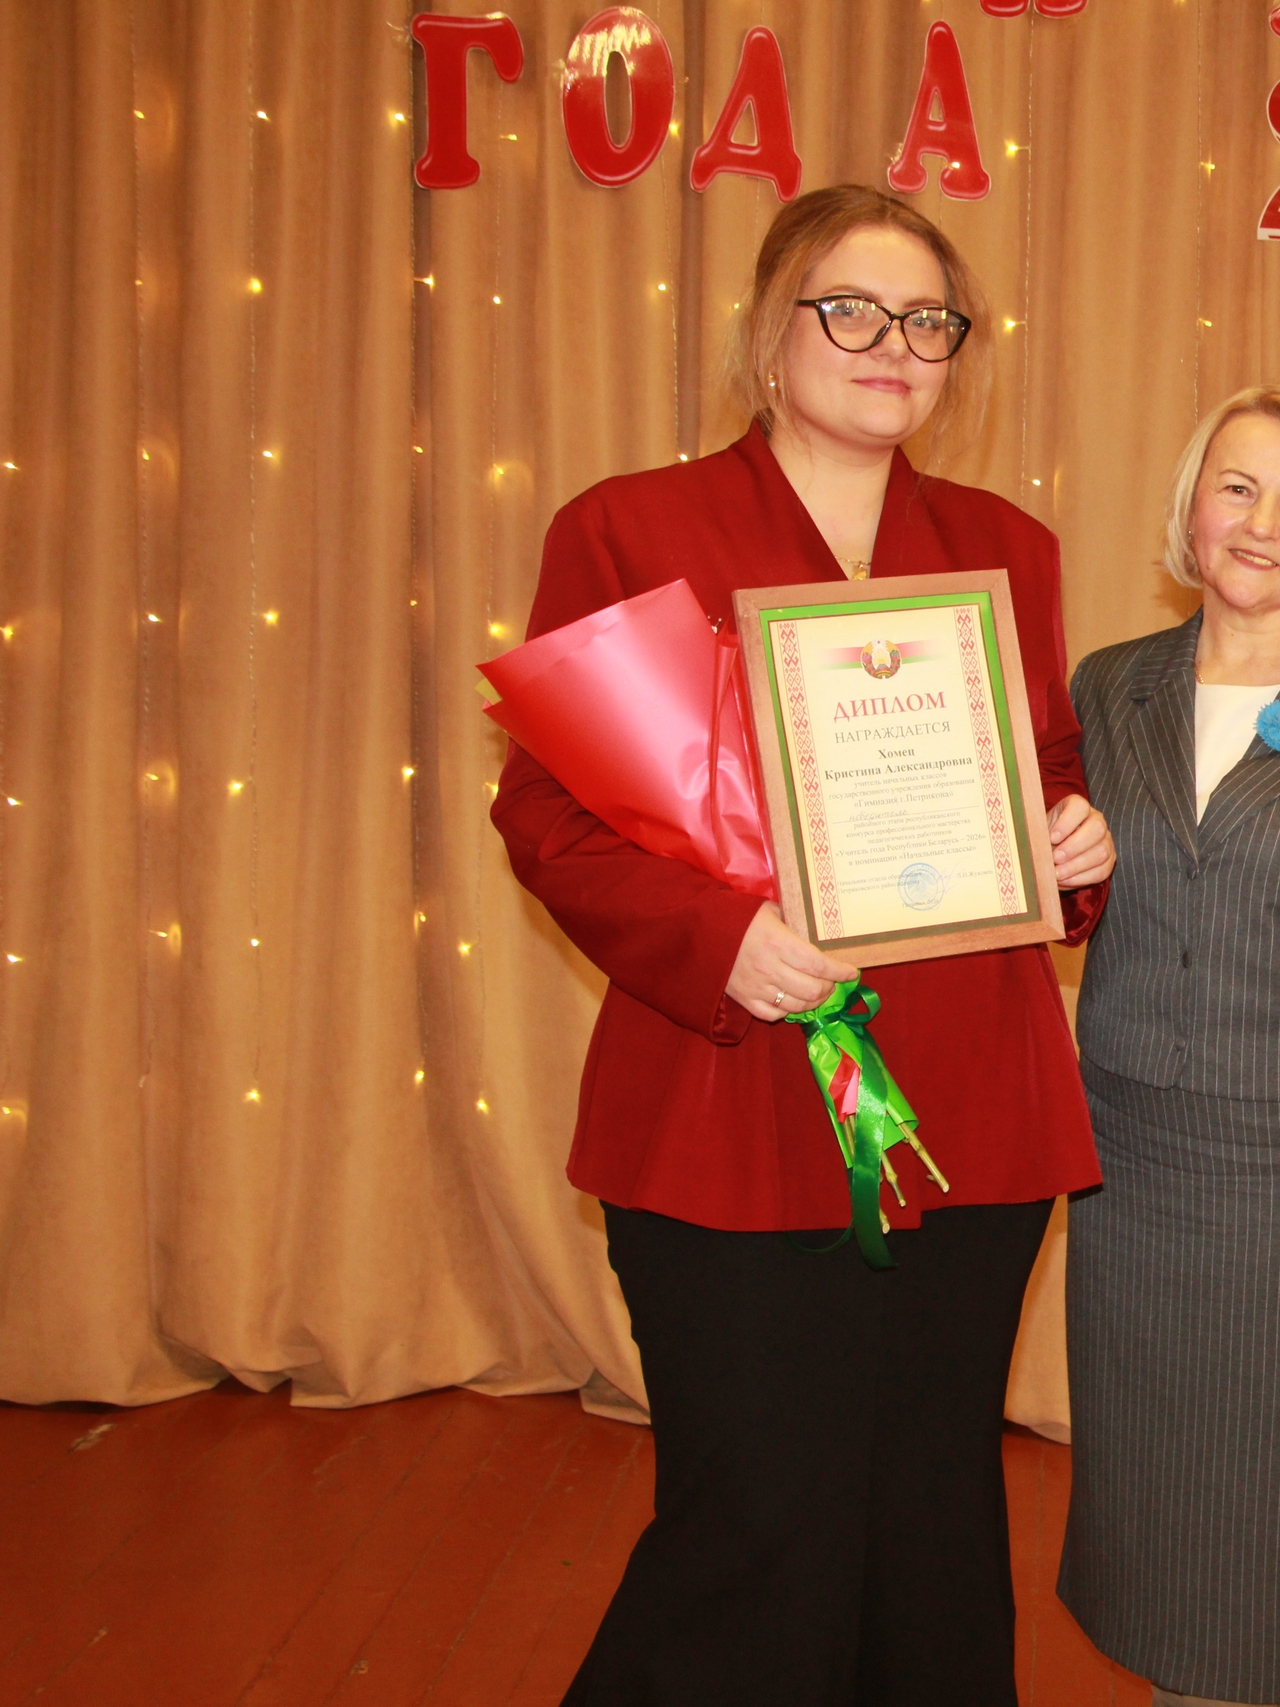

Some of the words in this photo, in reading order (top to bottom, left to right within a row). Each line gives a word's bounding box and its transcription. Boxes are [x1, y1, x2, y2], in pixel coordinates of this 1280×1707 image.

[411, 6, 991, 201] ГОДА
[833, 691, 947, 723] ДИПЛОМ
[835, 721, 950, 744] НАГРАЖДАЕТСЯ
[878, 749, 915, 759] Хомец
[824, 767, 881, 782] Кристина
[885, 757, 972, 774] Александровна
[829, 789, 889, 800] государственного
[891, 784, 931, 794] учреждения
[933, 779, 975, 788] образования
[854, 780, 881, 789] учитель
[883, 776, 919, 784] начальных
[854, 797, 898, 807] «Гимназия
[876, 823, 936, 835] профессионального
[937, 819, 971, 827] мастерства
[905, 812, 960, 824] республиканского
[868, 834, 915, 844] педагогических
[917, 830, 952, 839] работников
[835, 849, 868, 857] «Учитель
[887, 842, 927, 851] Республики
[928, 838, 959, 846] Беларусь
[855, 856, 897, 865] номинации
[899, 850, 944, 859] «Начальные
[946, 846, 976, 854] классы»
